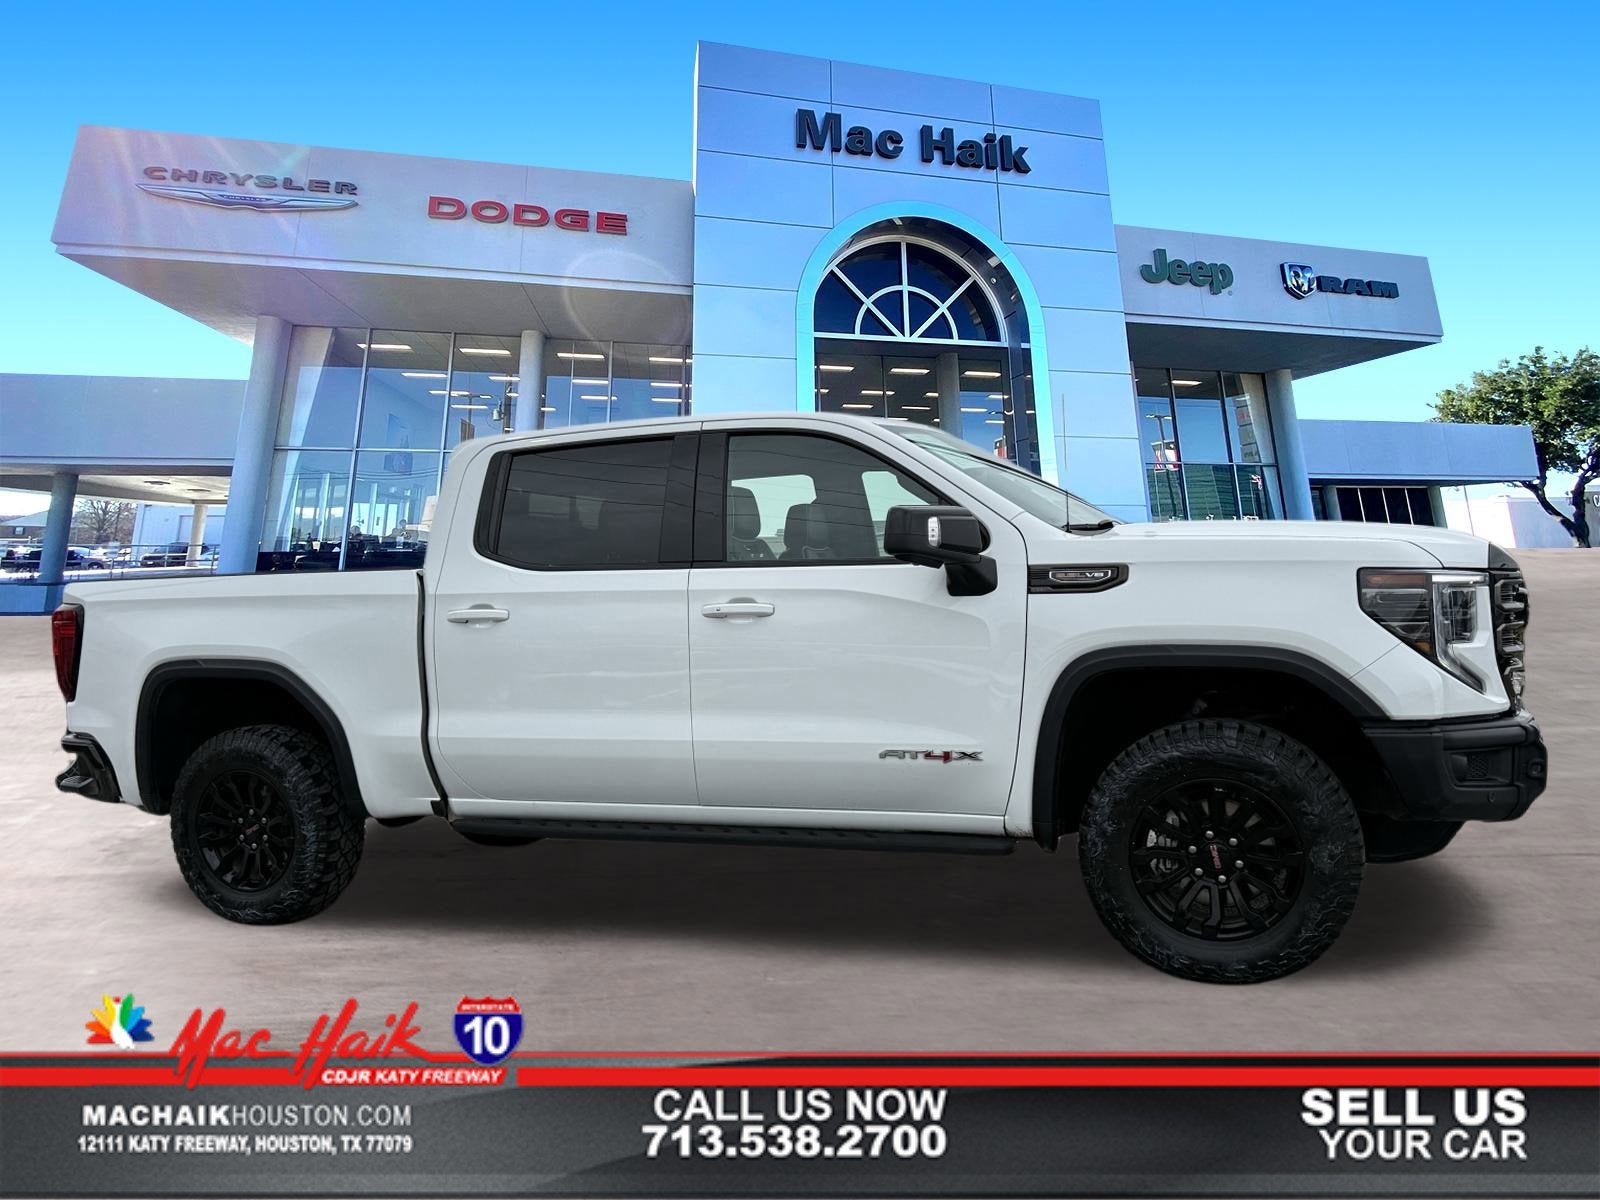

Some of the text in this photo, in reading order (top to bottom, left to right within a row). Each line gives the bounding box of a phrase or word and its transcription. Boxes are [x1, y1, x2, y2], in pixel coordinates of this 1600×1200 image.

[795, 108, 1032, 174] Mac Haik
[142, 165, 359, 196] CHRYSLER
[428, 195, 628, 236] DODGE
[1140, 248, 1234, 296] Jeep
[1315, 275, 1400, 299] RAM
